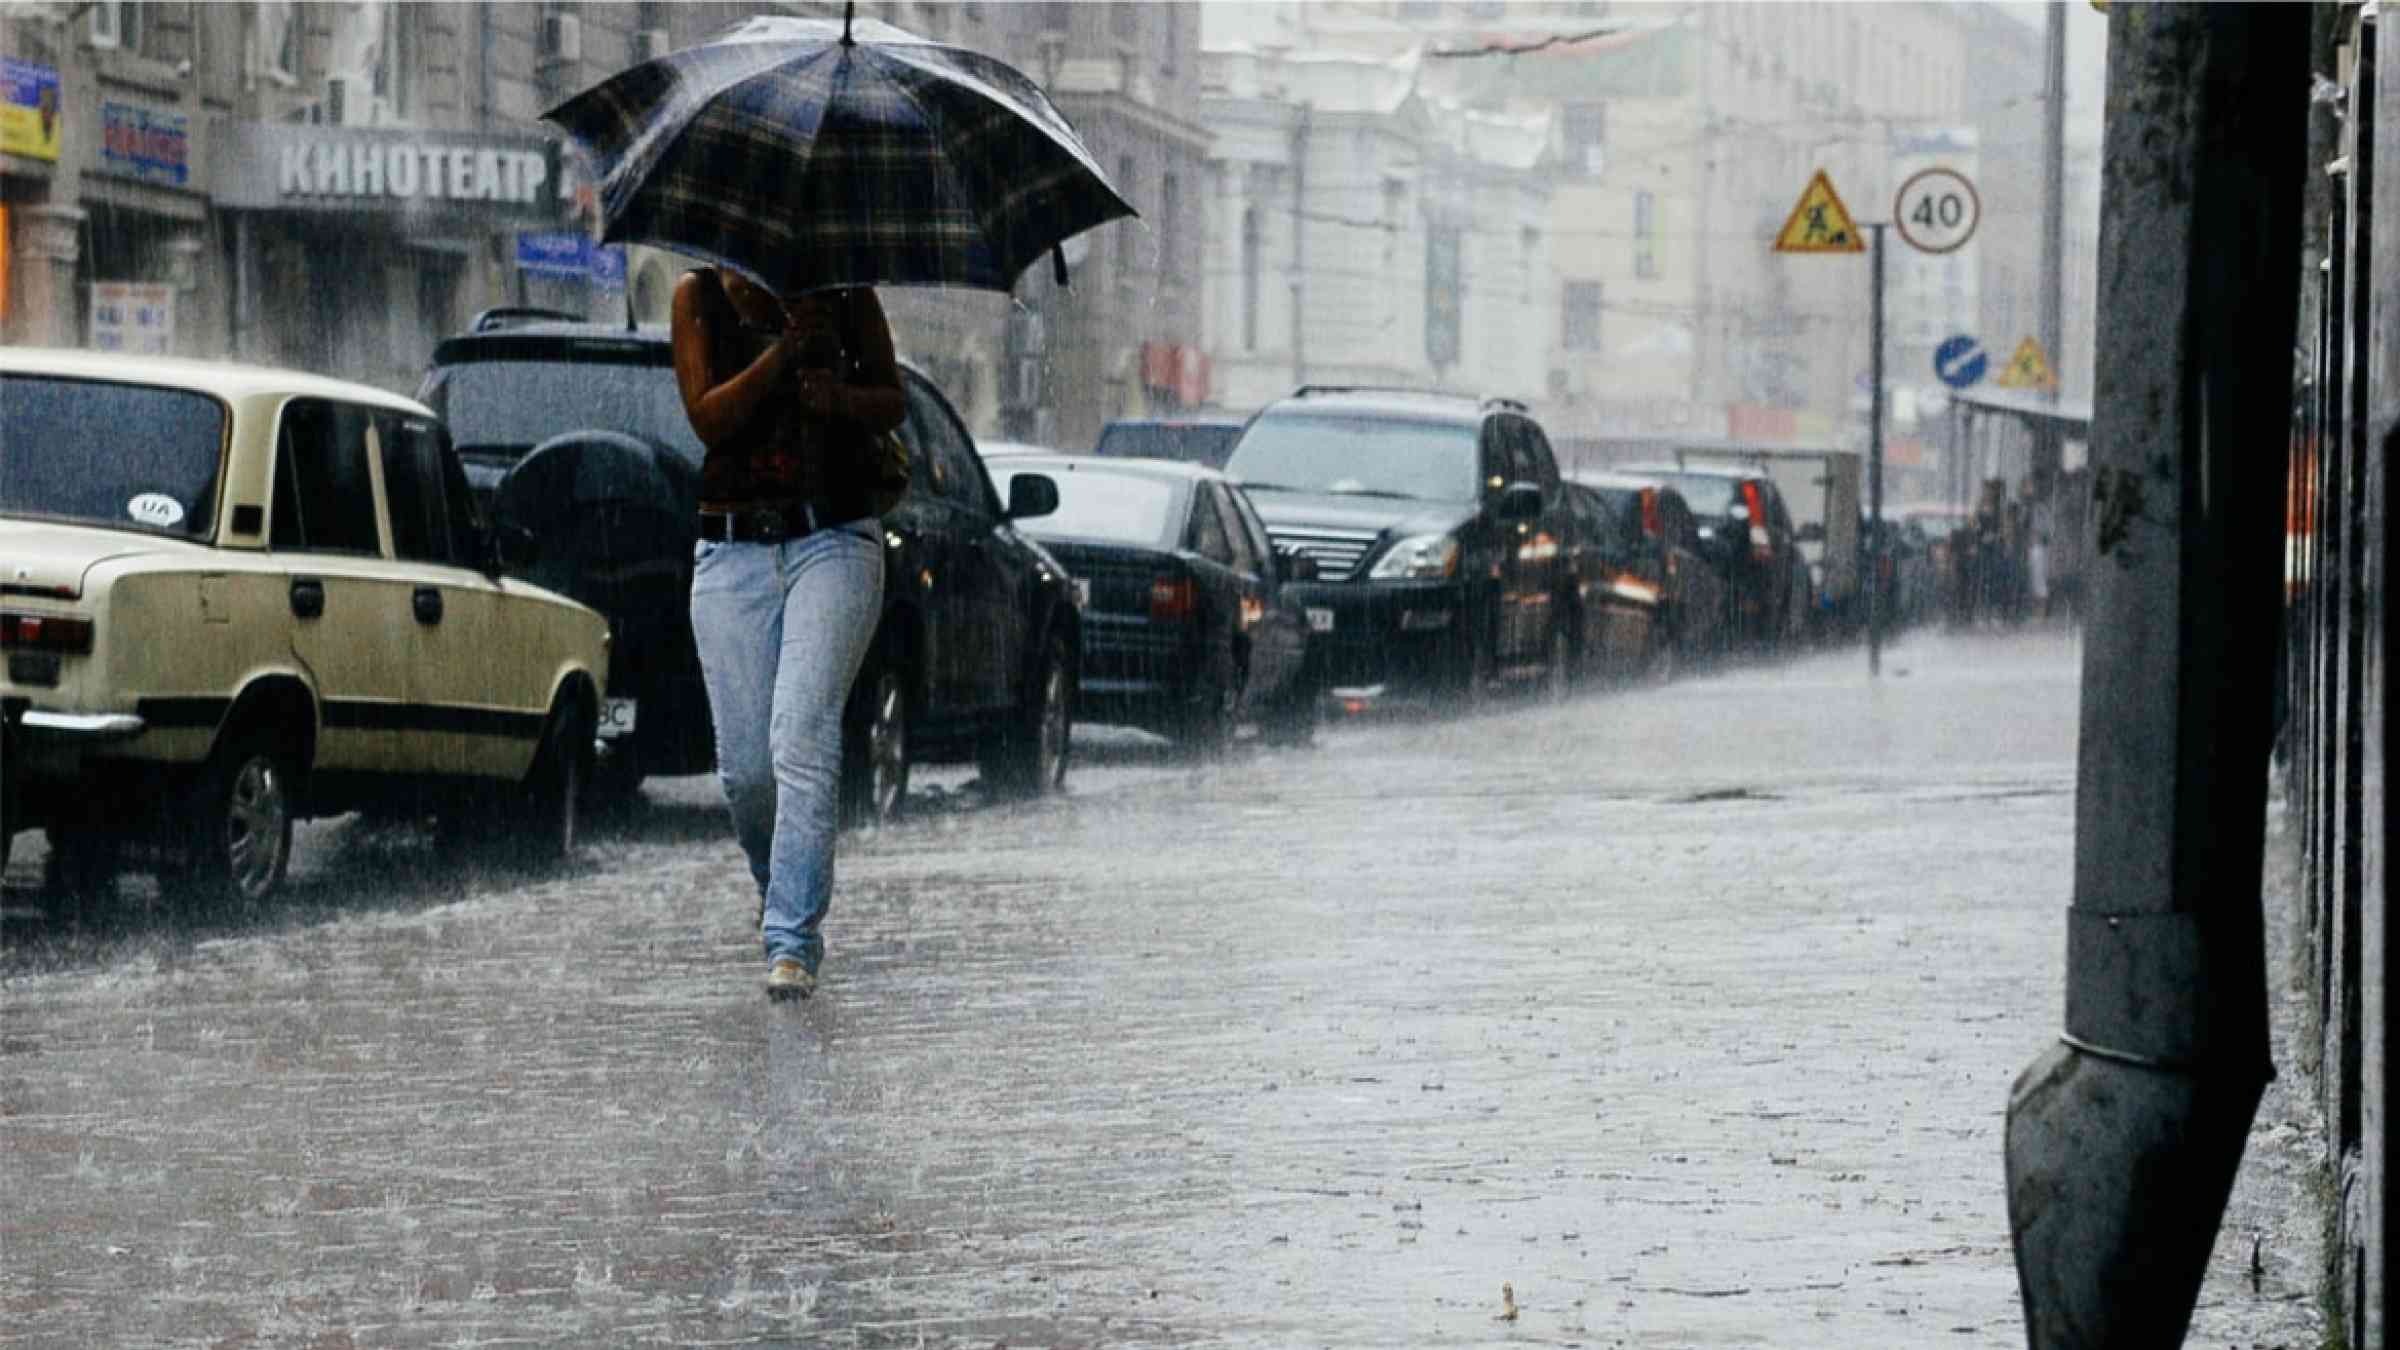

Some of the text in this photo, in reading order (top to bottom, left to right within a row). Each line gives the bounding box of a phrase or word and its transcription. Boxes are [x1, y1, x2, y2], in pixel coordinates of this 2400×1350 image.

[278, 144, 547, 202] КИНОТЕАТР
[1911, 194, 1962, 228] 40
[142, 499, 169, 515] UA
